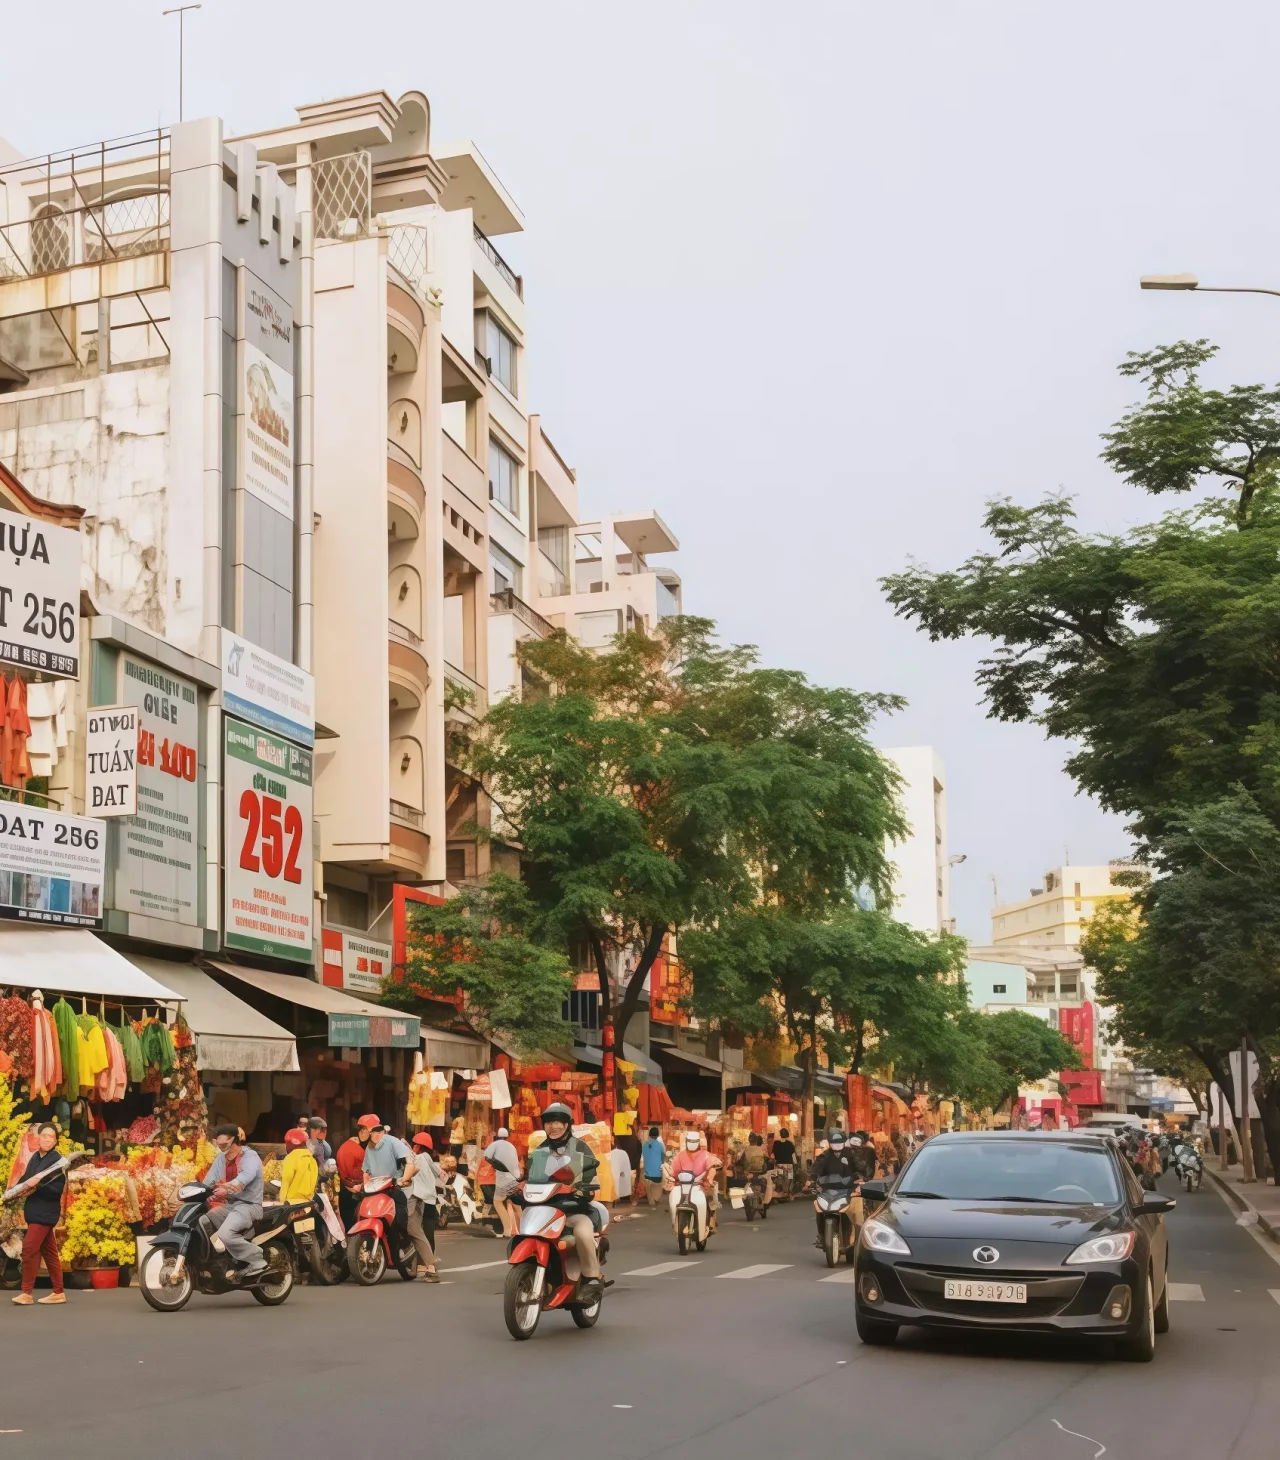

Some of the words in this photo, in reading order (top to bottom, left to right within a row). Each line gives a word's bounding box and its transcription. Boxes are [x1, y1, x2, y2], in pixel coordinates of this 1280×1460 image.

[22, 592, 75, 644] 256
[53, 823, 100, 850] 256
[239, 789, 303, 885] 252
